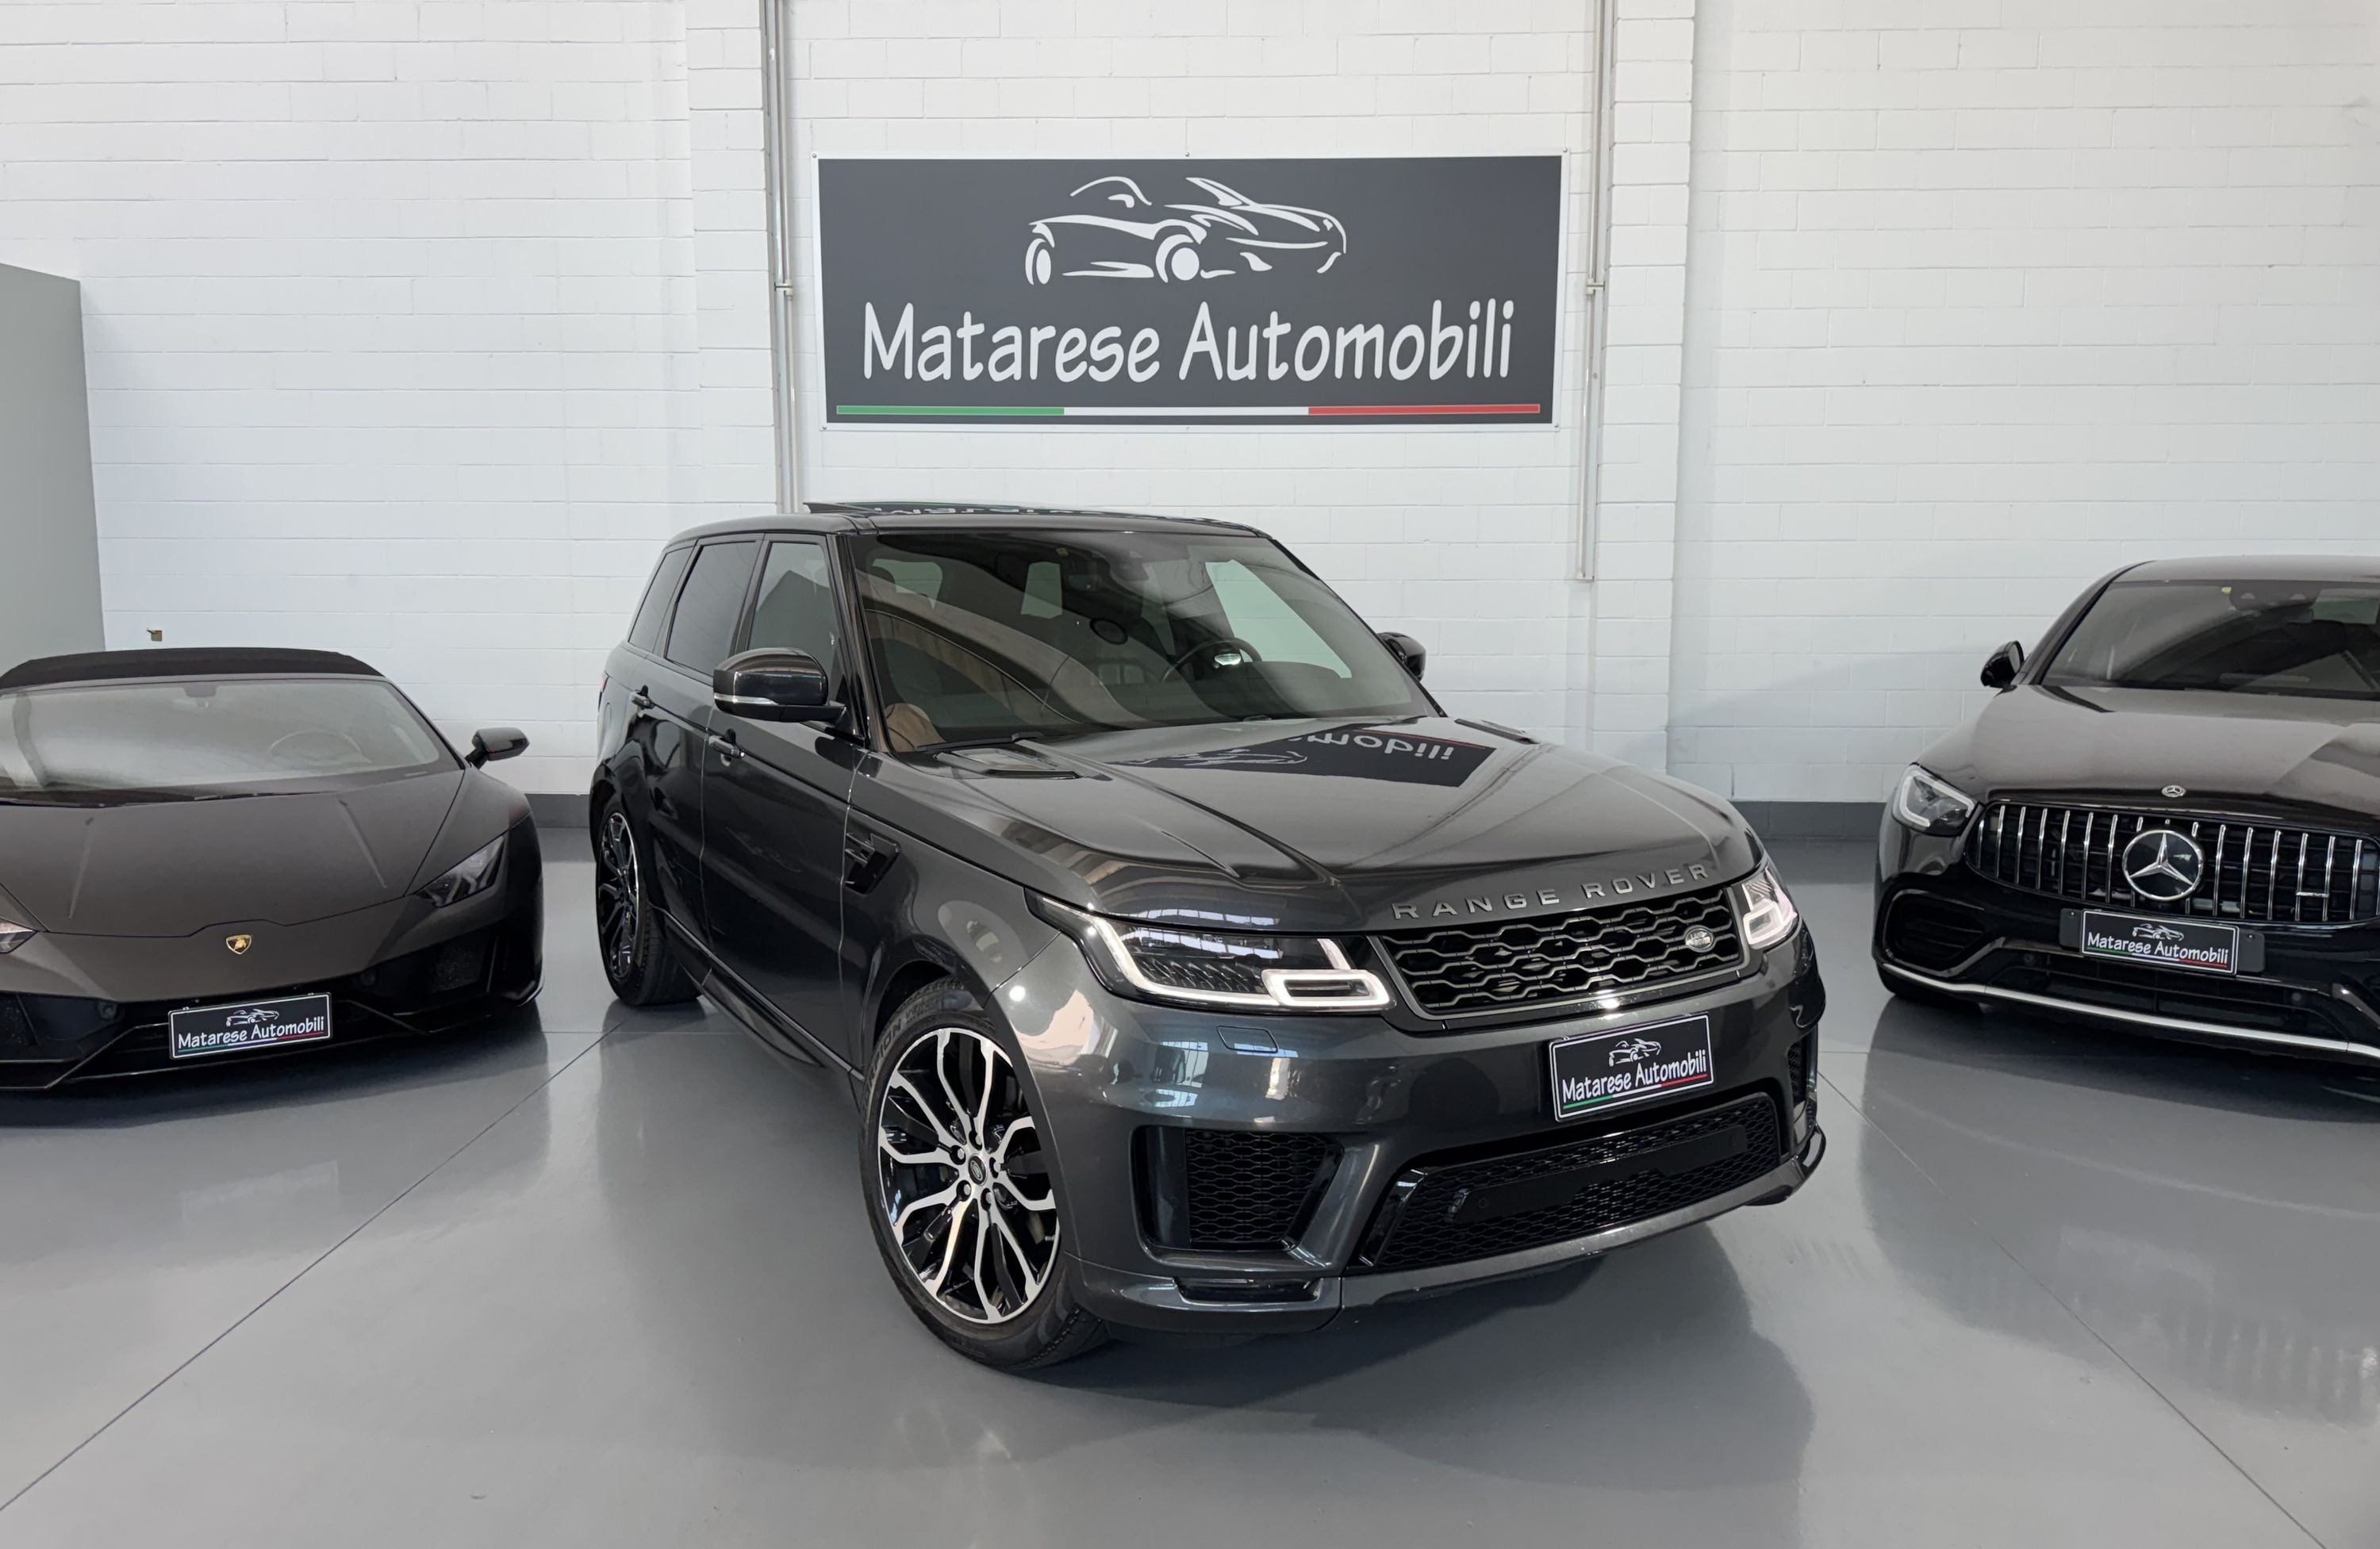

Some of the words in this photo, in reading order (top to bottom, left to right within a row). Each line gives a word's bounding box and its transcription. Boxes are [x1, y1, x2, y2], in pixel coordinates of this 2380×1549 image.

[863, 301, 1160, 382] Matarese
[1179, 298, 1514, 381] Automobili
[1392, 888, 1560, 919] RANGE
[1582, 864, 1708, 899] ROVER
[2087, 932, 2151, 954] Matarese
[2154, 941, 2228, 964] Automobili
[178, 1029, 248, 1049] Matarese
[251, 1016, 324, 1040] Automobili
[1562, 1075, 1632, 1104] Matarese
[1635, 1049, 1706, 1086] Automobili
